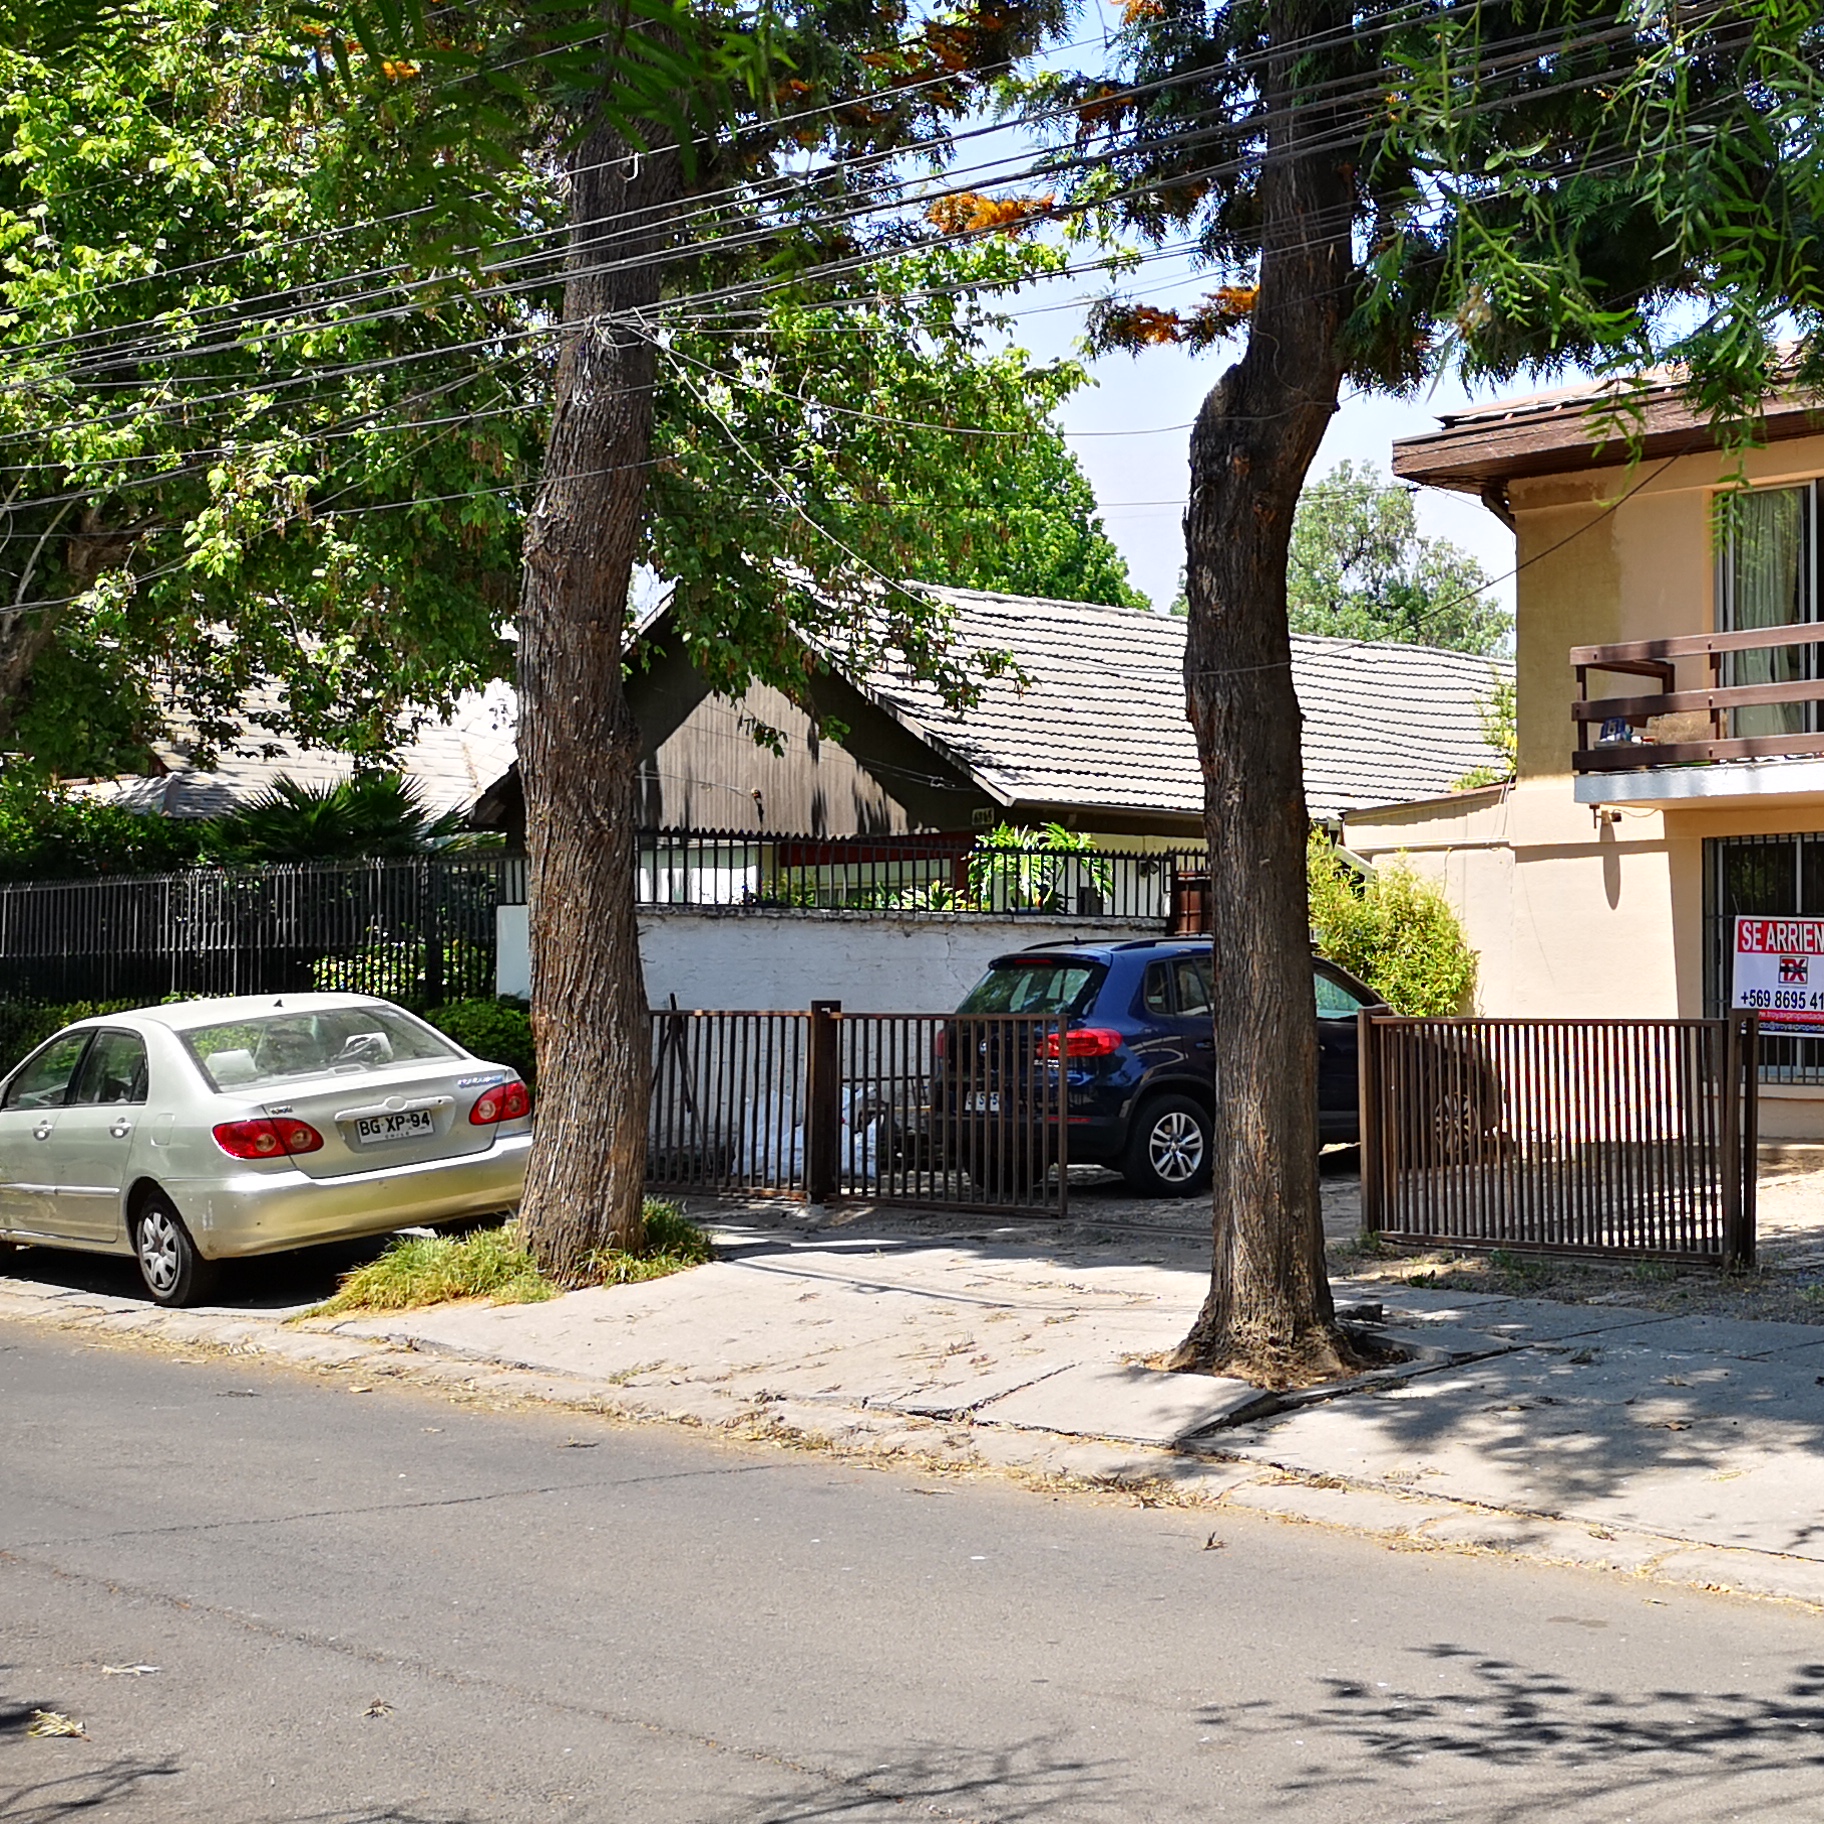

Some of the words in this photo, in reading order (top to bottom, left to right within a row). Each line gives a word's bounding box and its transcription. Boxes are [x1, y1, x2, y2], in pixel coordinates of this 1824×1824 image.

[1742, 922, 1762, 951] SE
[1741, 989, 1771, 1008] +569
[1775, 990, 1806, 1010] 8695
